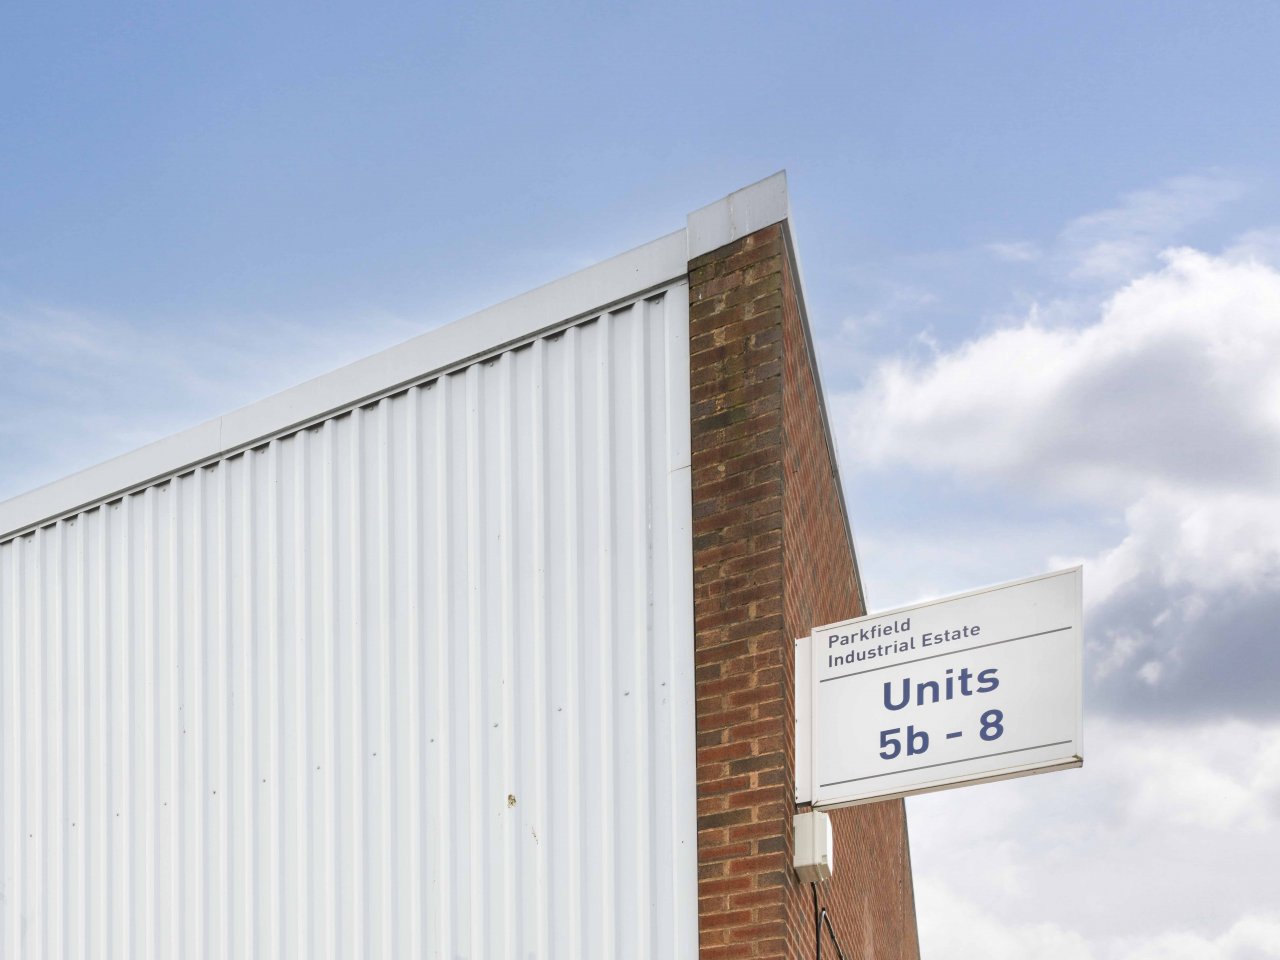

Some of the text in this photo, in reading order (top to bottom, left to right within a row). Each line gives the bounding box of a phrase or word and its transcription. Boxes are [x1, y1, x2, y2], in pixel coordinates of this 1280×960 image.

[828, 617, 911, 648] Parkfield
[828, 625, 981, 668] Industrial Estate
[883, 667, 1000, 711] Units
[879, 725, 930, 760] 5b
[979, 708, 1004, 742] 8
